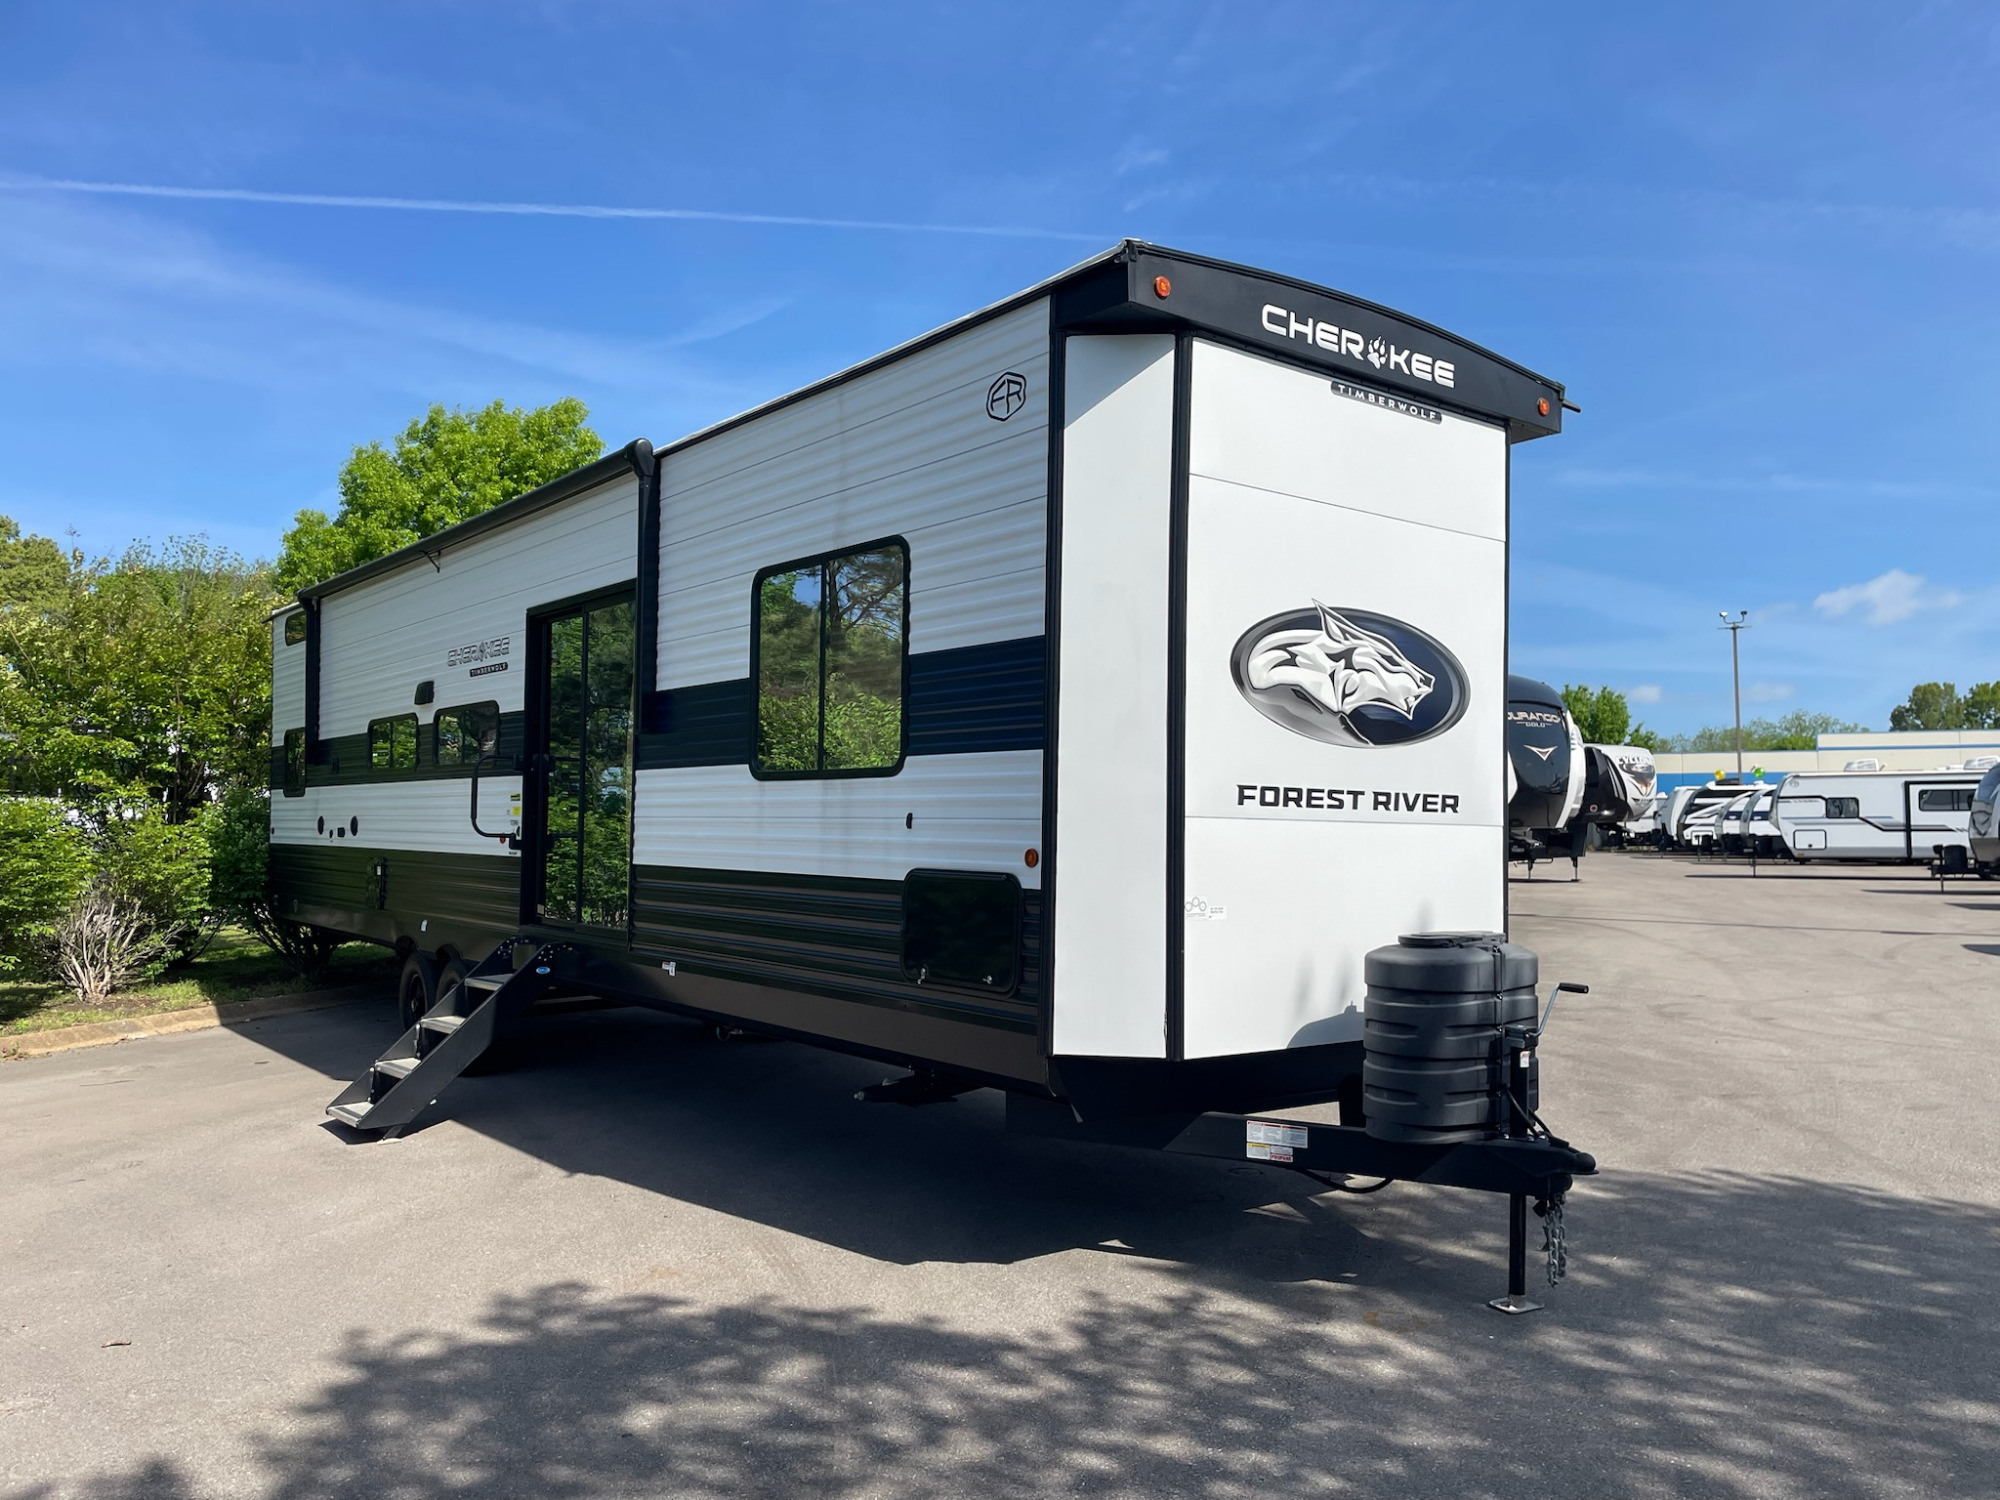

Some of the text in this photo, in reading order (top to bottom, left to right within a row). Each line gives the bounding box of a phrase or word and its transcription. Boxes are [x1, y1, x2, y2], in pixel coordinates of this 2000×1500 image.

[1338, 384, 1436, 420] TIMBERWOLF
[1236, 784, 1460, 814] FOREST RIVER
